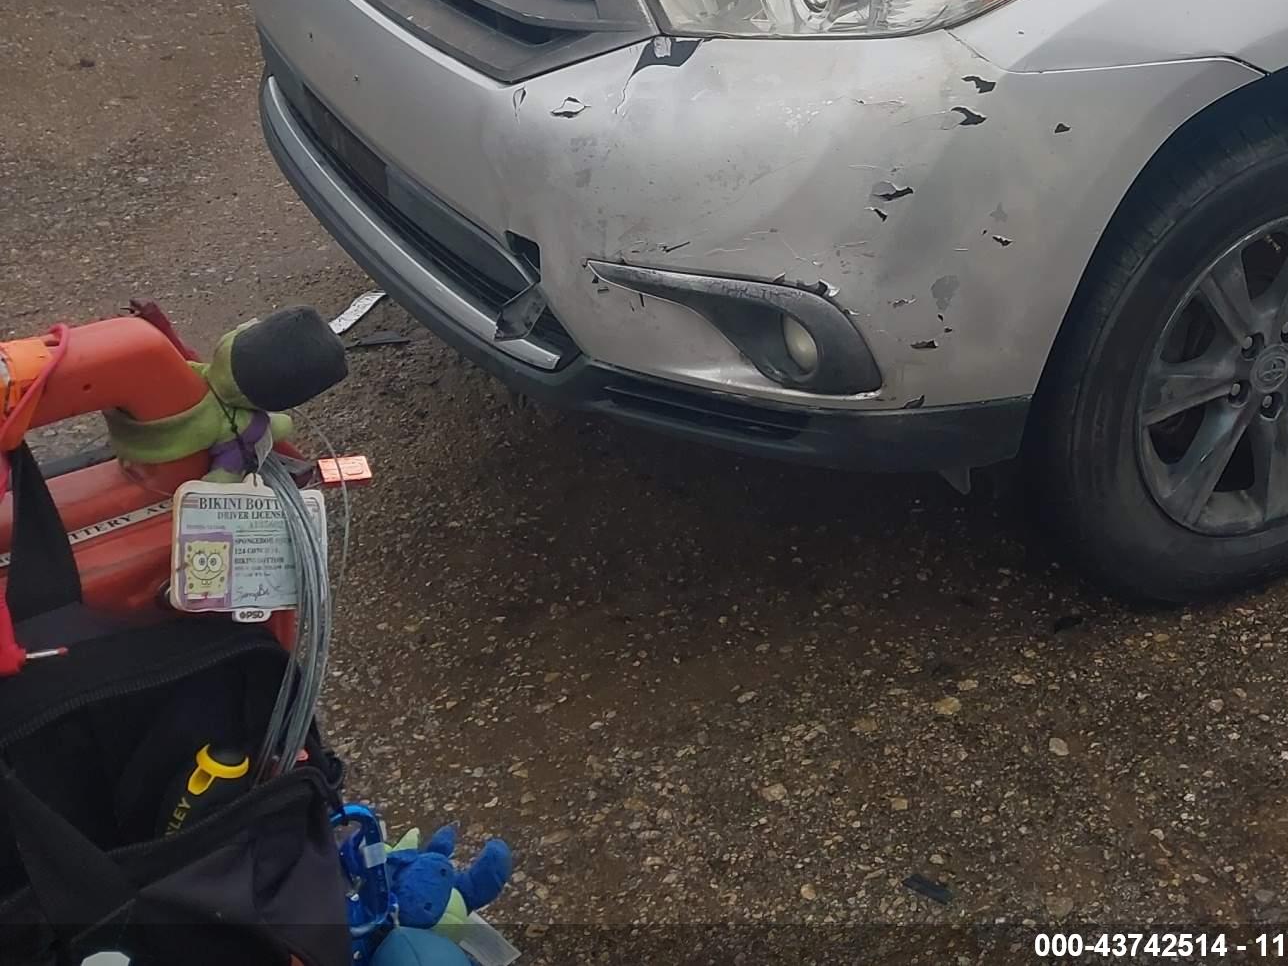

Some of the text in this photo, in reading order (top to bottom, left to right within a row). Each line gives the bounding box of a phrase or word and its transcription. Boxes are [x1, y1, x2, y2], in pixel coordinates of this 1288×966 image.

[199, 497, 284, 510] BIKINI BOTT
[217, 511, 248, 520] DRIVER
[245, 611, 265, 619] PSD
